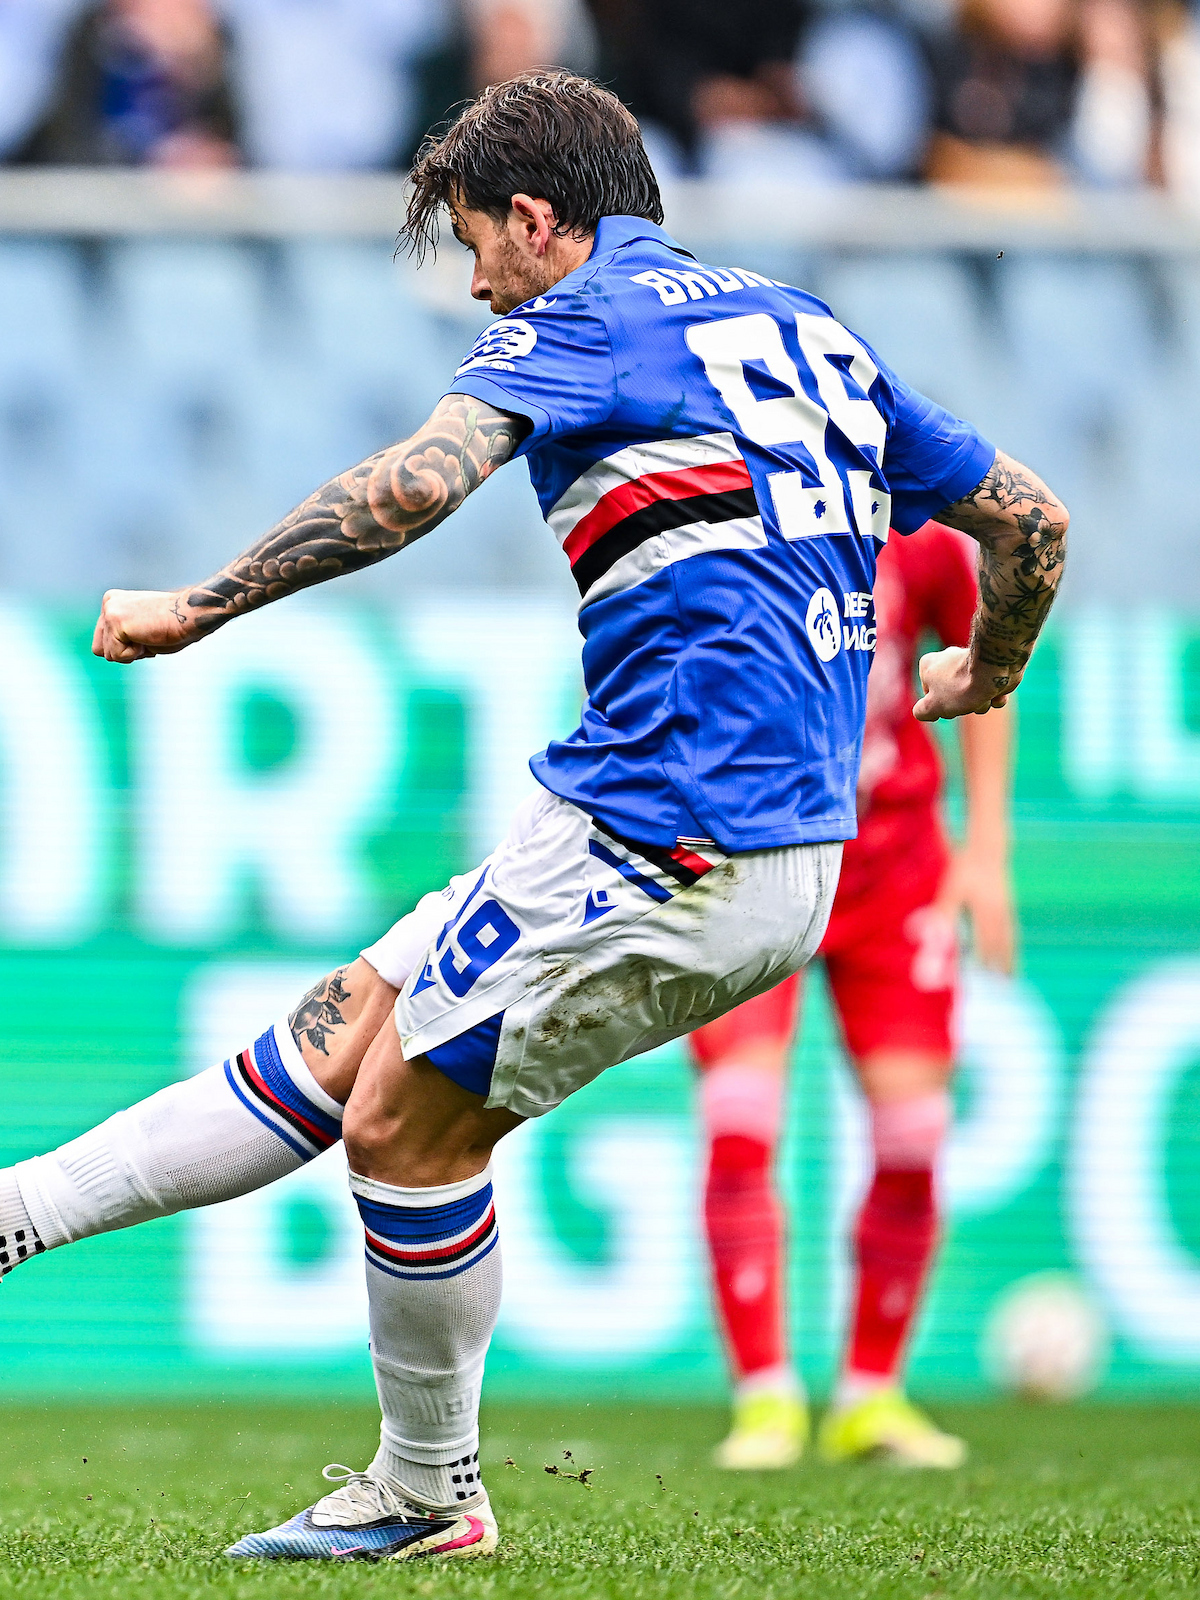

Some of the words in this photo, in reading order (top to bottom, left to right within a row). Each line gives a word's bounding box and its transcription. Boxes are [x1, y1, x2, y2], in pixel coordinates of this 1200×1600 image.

[628, 266, 792, 307] BRUN
[684, 311, 892, 545] 99
[435, 863, 521, 998] 9
